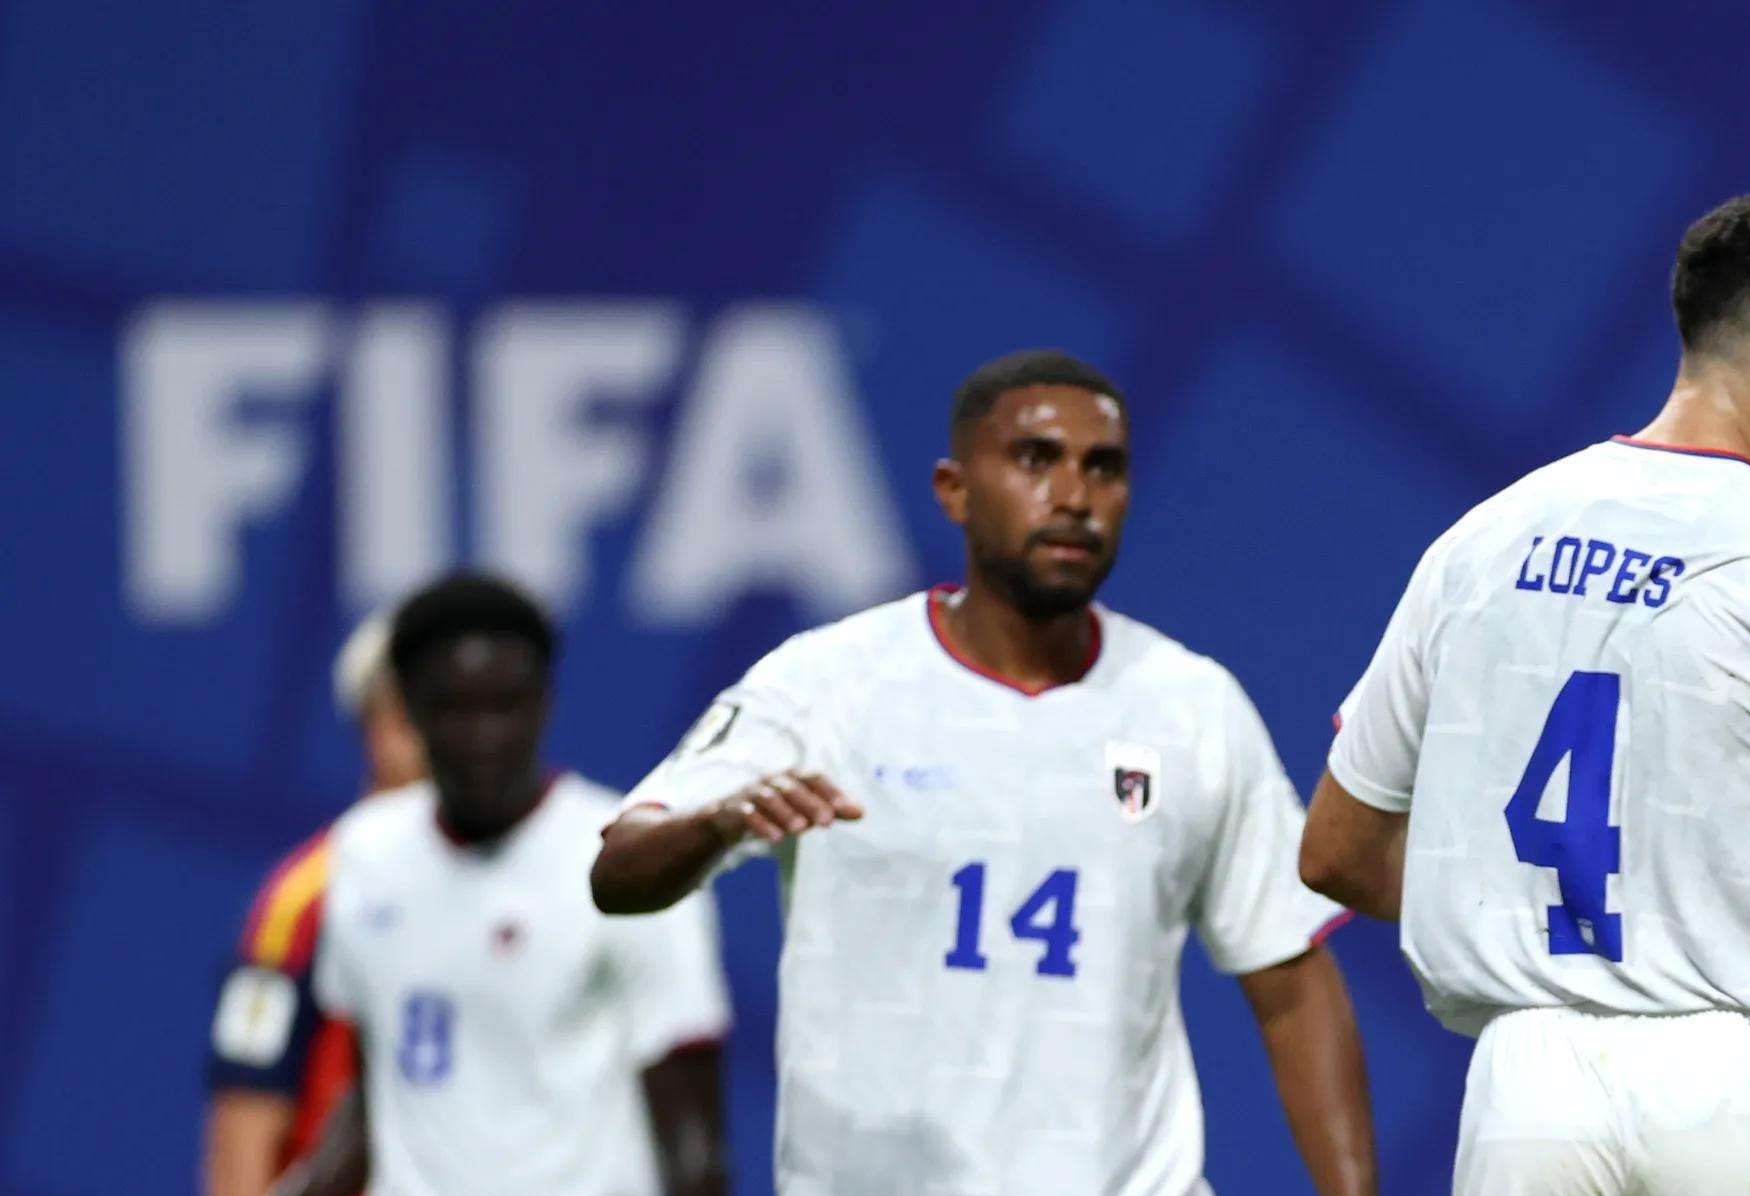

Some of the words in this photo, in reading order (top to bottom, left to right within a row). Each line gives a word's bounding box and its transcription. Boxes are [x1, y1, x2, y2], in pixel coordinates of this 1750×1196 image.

[124, 303, 908, 619] FIFA
[1515, 536, 1685, 609] LOPES
[1504, 670, 1623, 963] 4
[944, 861, 1081, 978] 14
[402, 993, 454, 1085] 8
